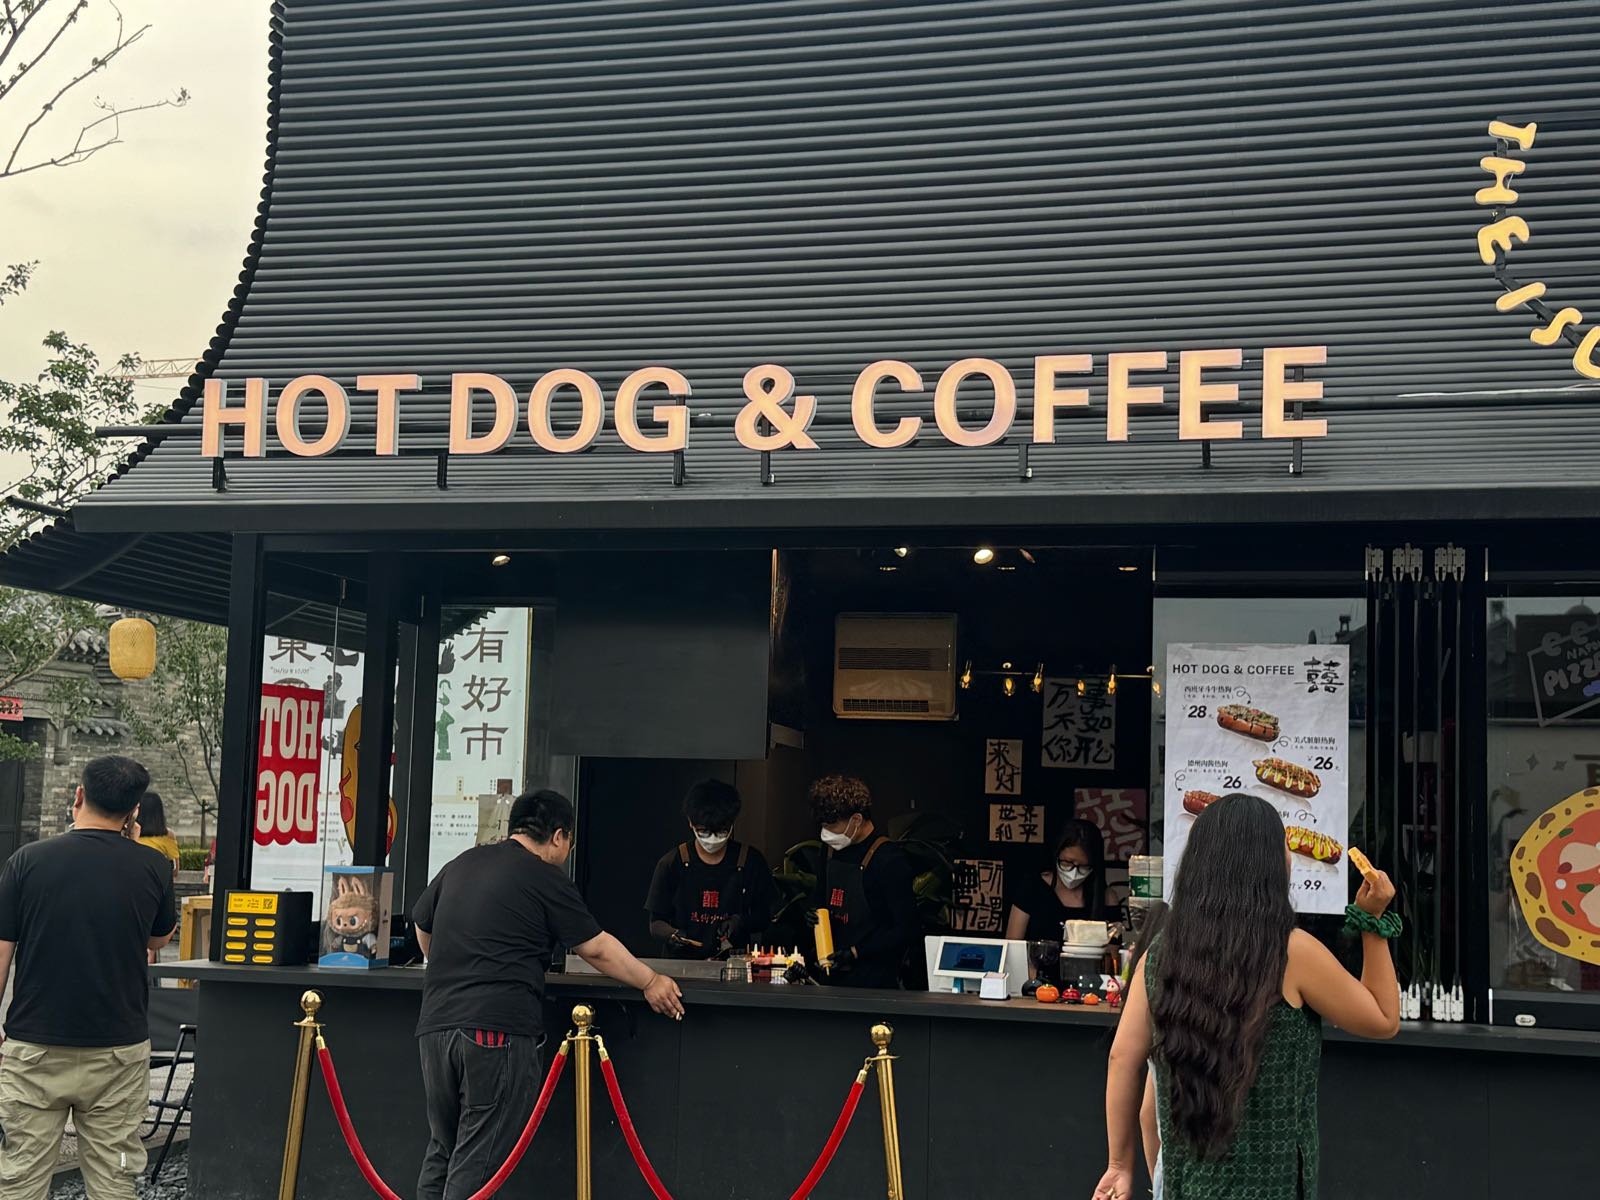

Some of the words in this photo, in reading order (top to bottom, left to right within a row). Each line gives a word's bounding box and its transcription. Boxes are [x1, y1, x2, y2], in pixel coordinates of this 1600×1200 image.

[201, 373, 423, 458] HOT
[449, 366, 692, 455] DOG
[734, 363, 821, 451] &
[851, 345, 1328, 449] COFFEE
[1172, 664, 1199, 675] HOT
[1202, 664, 1230, 675] DOG
[1233, 664, 1244, 675] &
[1247, 664, 1295, 676] COFFEE
[460, 626, 512, 762] 有好市
[1187, 705, 1207, 719] 28
[1313, 756, 1333, 770] 26
[1222, 776, 1242, 789] 26
[1303, 880, 1322, 891] 9.9
